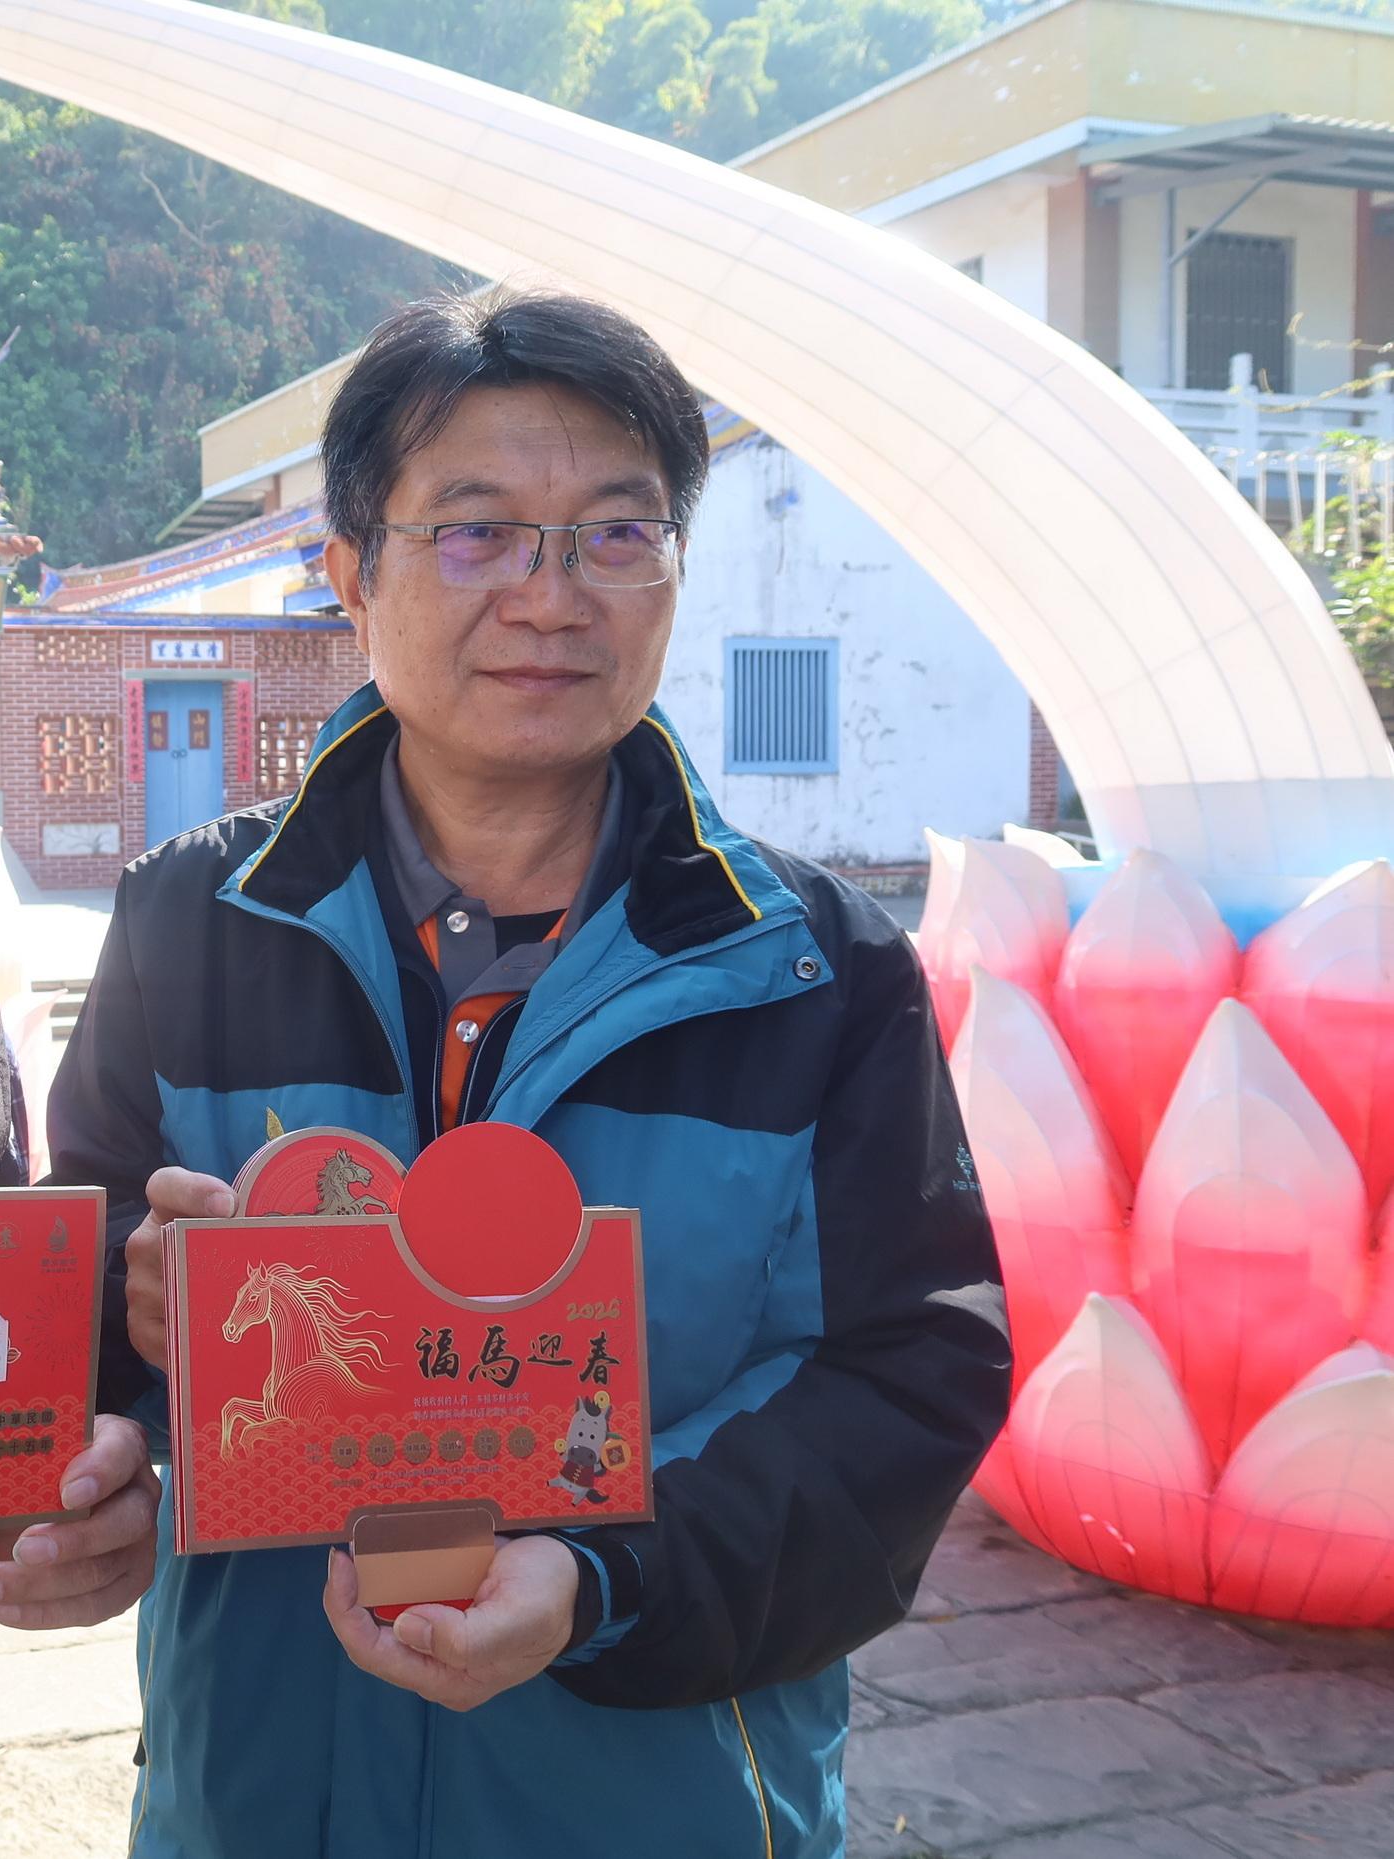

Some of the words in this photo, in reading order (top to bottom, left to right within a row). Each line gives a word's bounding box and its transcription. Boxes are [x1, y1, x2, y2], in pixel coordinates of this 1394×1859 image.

[567, 1298, 622, 1321] 2026
[414, 1324, 621, 1389] 福馬迎春
